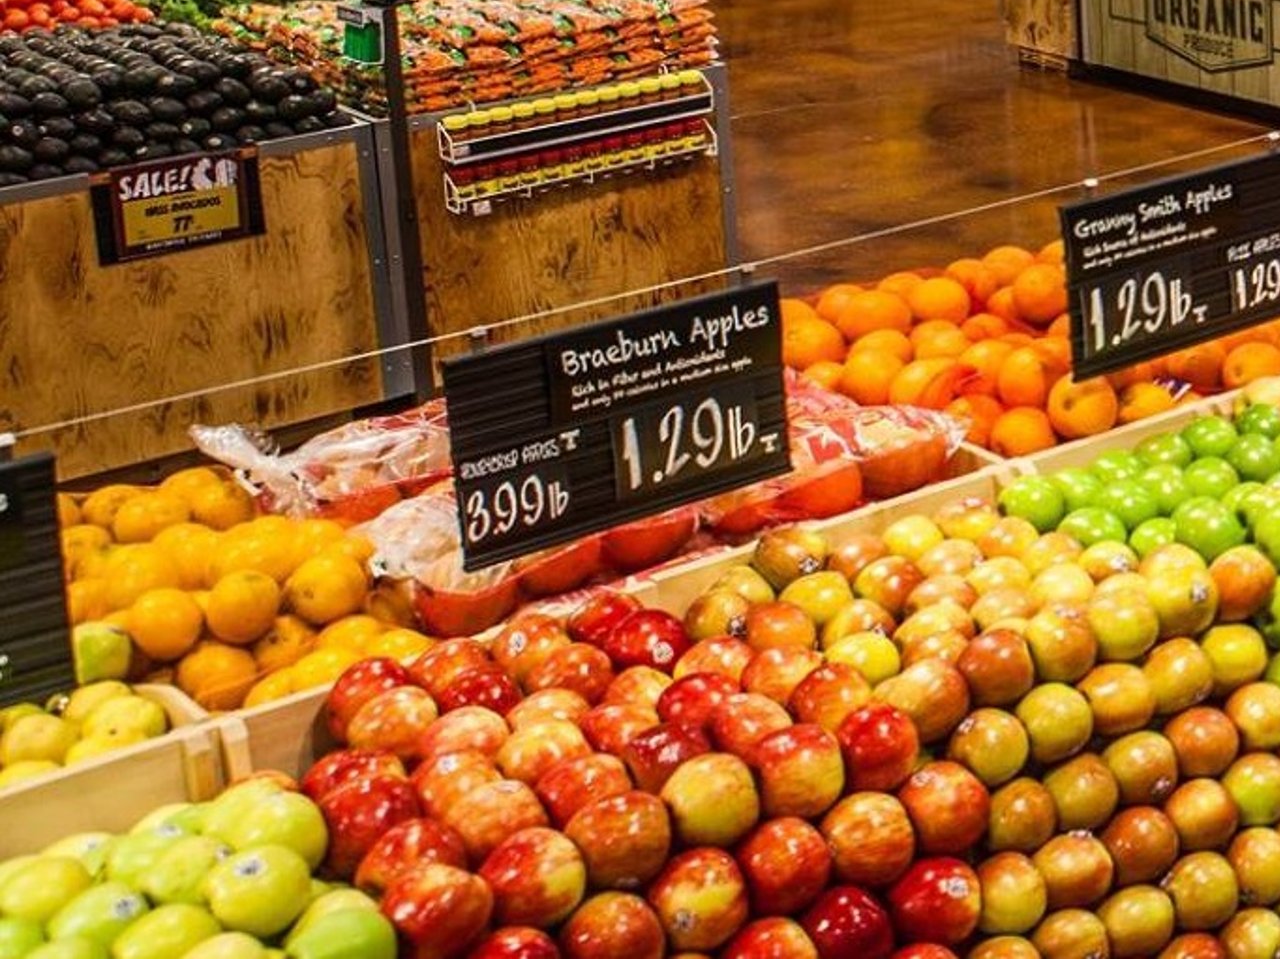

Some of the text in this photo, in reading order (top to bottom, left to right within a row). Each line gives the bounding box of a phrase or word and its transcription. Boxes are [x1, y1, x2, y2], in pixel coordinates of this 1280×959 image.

[118, 164, 191, 200] SALE!
[1074, 184, 1233, 238] Granny Smith Apples
[560, 305, 769, 376] Braeburn Apples
